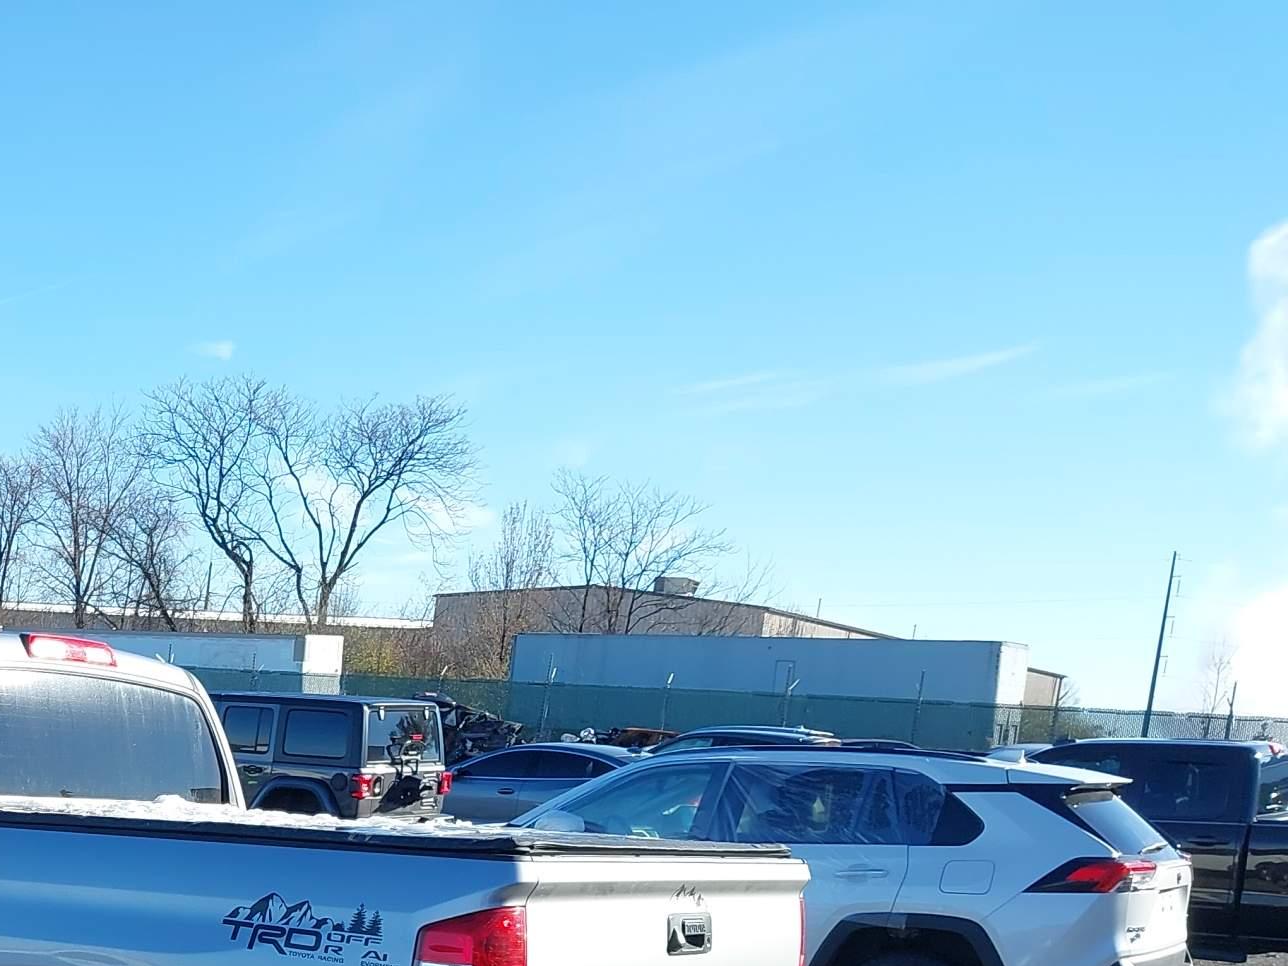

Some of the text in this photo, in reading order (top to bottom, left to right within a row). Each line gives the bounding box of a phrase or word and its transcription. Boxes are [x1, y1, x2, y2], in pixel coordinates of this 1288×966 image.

[222, 918, 383, 956] TRD OFF
[287, 950, 315, 961] TOYOTA
